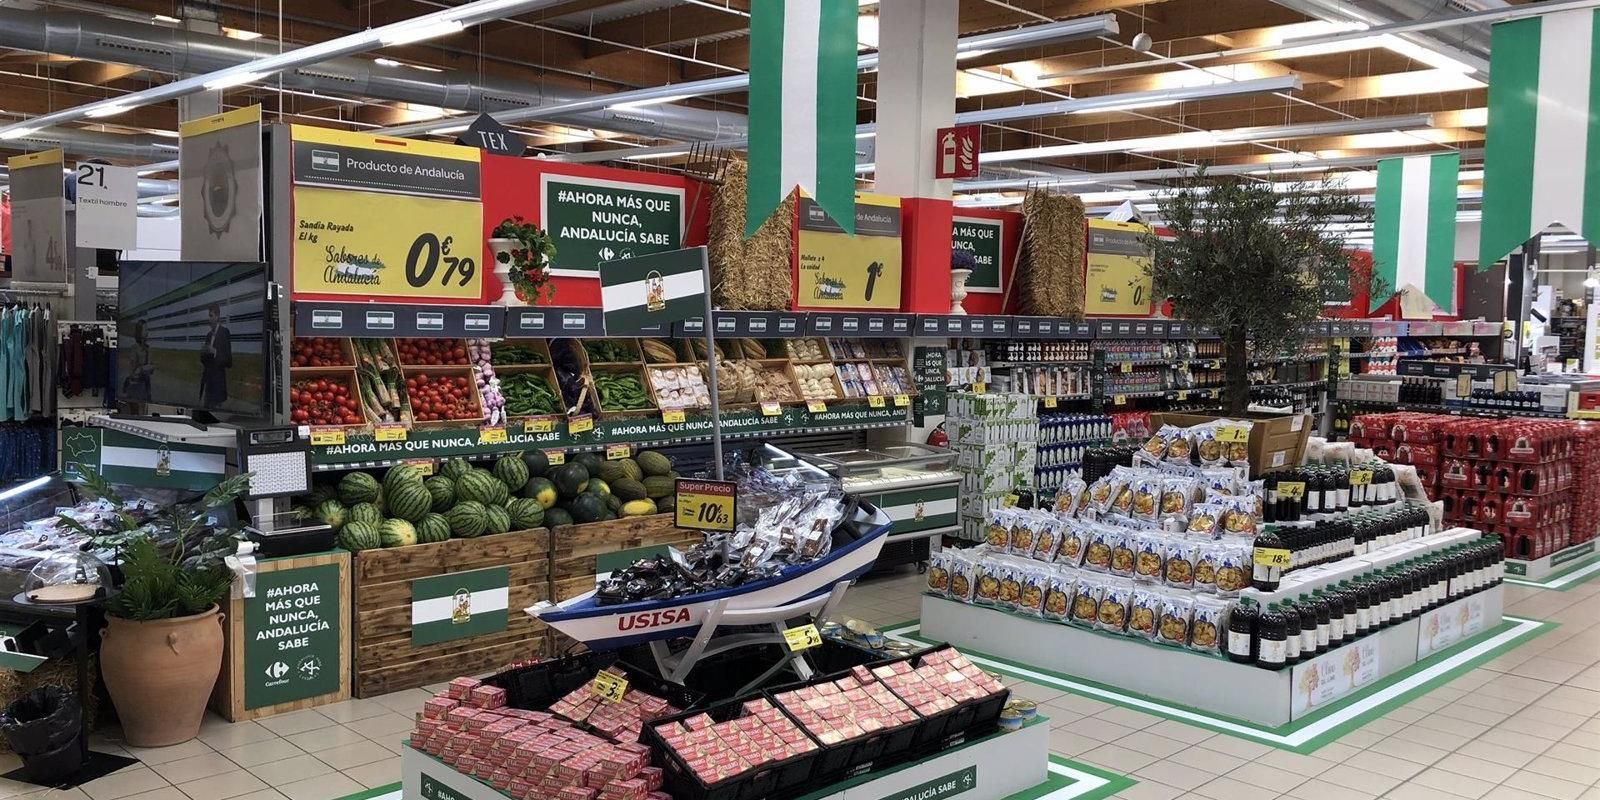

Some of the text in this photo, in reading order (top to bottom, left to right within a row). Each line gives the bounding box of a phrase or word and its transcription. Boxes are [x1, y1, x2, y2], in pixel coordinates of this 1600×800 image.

[478, 131, 508, 150] TEX
[78, 165, 104, 187] 21
[347, 158, 465, 180] Producto de Andalucía
[100, 199, 128, 207] hombre
[558, 190, 670, 212] #AHORA MÁS QUE
[327, 222, 354, 232] Rayada
[592, 211, 642, 227] NUNCA,
[299, 232, 318, 244] El kg
[561, 227, 669, 245] ANDALUCÍA SABE
[960, 226, 976, 237] MÁS
[977, 229, 994, 238] QUE
[326, 245, 368, 264] Sabores
[974, 255, 993, 265] SABE
[324, 266, 380, 285] Andalucía
[612, 426, 647, 435] #AHORA
[649, 424, 666, 432] MÁS
[668, 423, 684, 432] QUE
[761, 416, 778, 424] SABE
[327, 444, 376, 455] #AHORA
[405, 440, 429, 451] QUE
[432, 438, 475, 448] NUNCA,
[537, 432, 560, 441] SABE
[680, 482, 731, 493] Super Precio
[267, 582, 319, 598] #AHORA
[266, 596, 320, 612] MÁS QUE
[270, 610, 318, 625] NUNCA,
[619, 608, 690, 630] USISA
[256, 620, 330, 640] ANDALUCÍA
[278, 637, 309, 650] SABE
[265, 678, 289, 687] Carrefour
[938, 780, 956, 794] SABE
